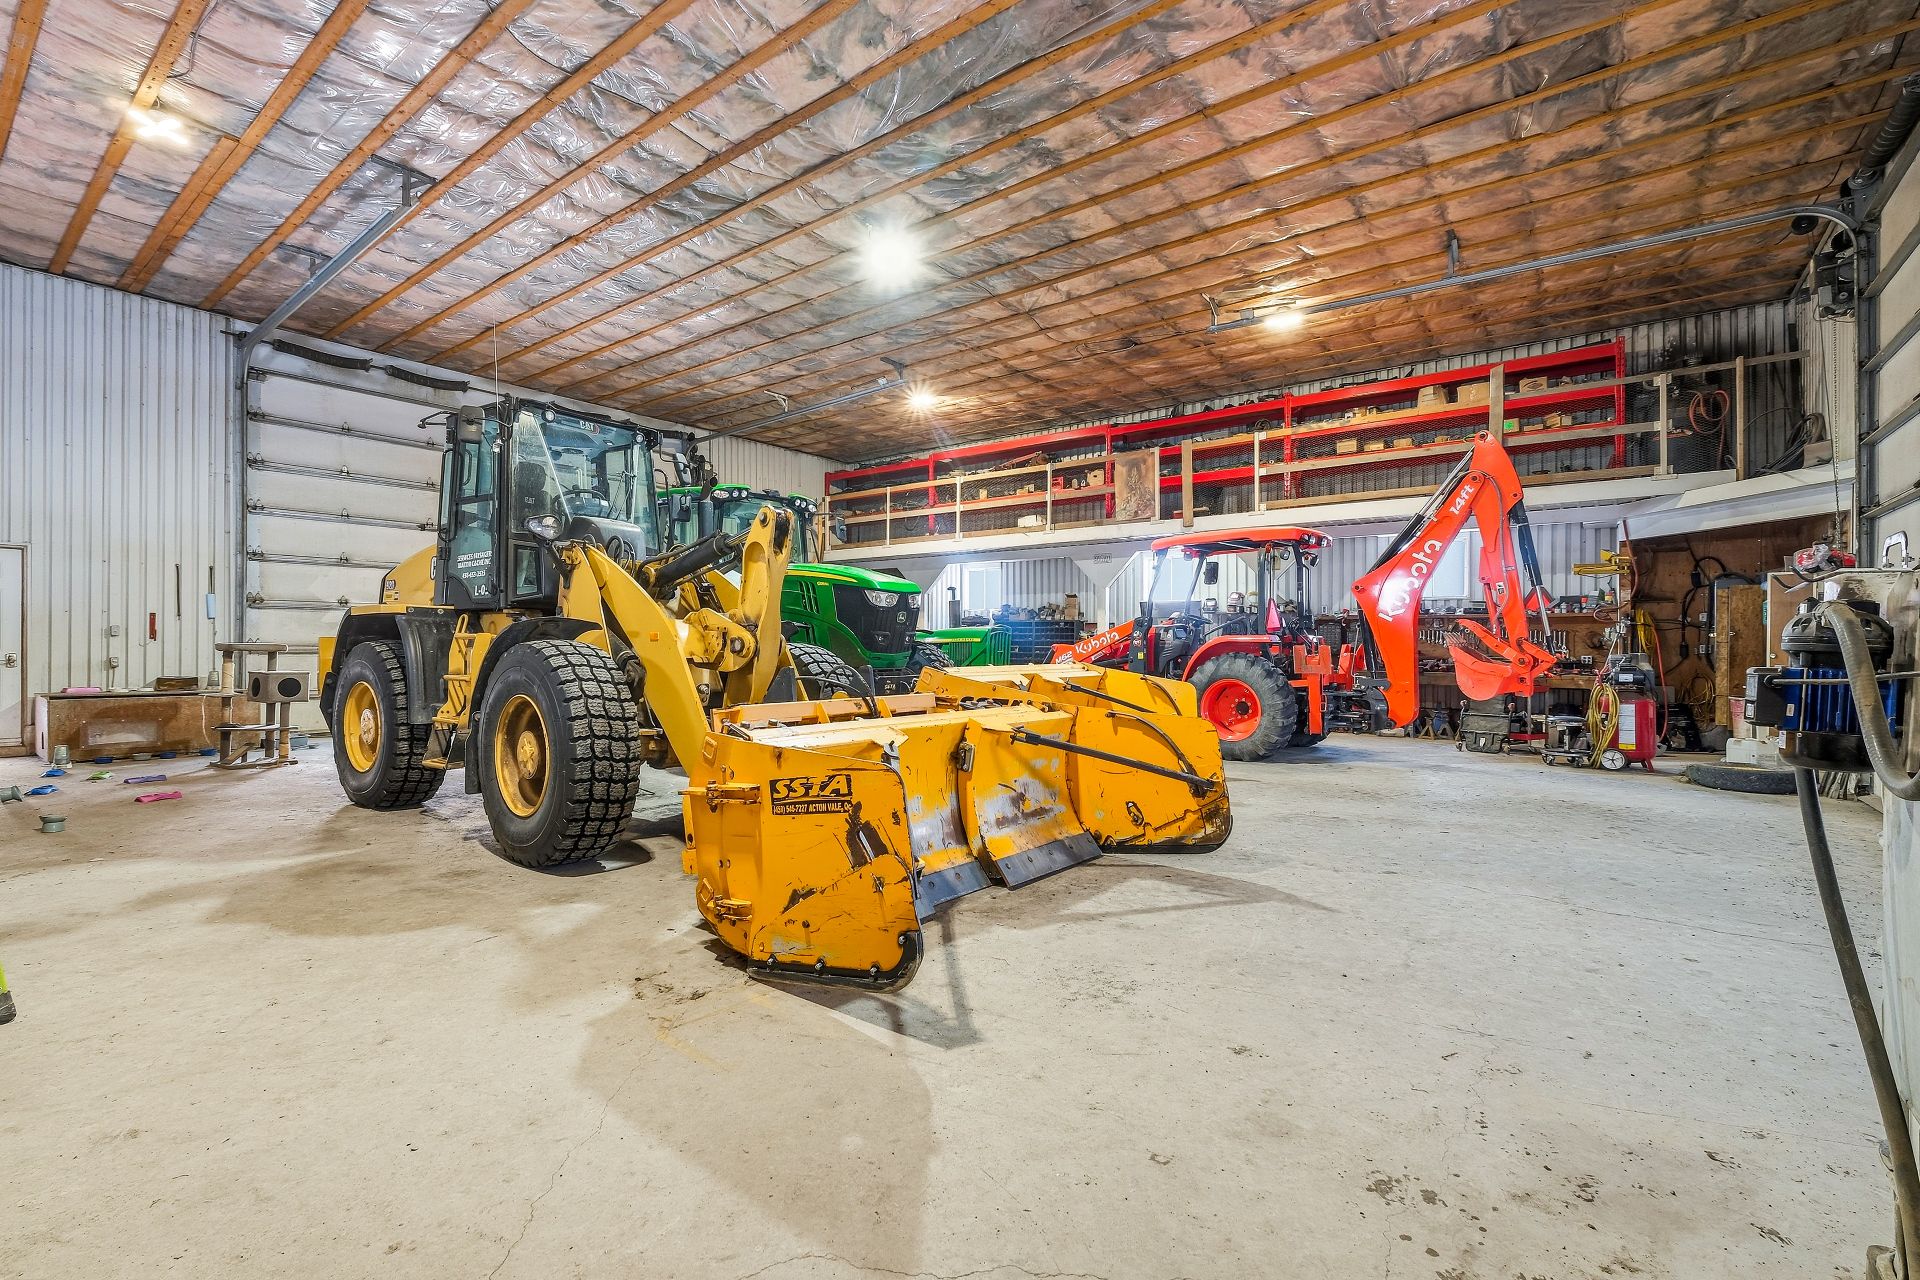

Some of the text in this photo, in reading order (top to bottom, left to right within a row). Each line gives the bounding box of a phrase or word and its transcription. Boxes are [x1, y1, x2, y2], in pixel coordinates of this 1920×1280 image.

[579, 420, 594, 432] CAT
[1450, 483, 1476, 515] 14ft
[1377, 539, 1443, 622] Kubota
[1075, 631, 1120, 654] Kubota
[772, 775, 849, 798] SSTA
[809, 803, 827, 813] ACTON
